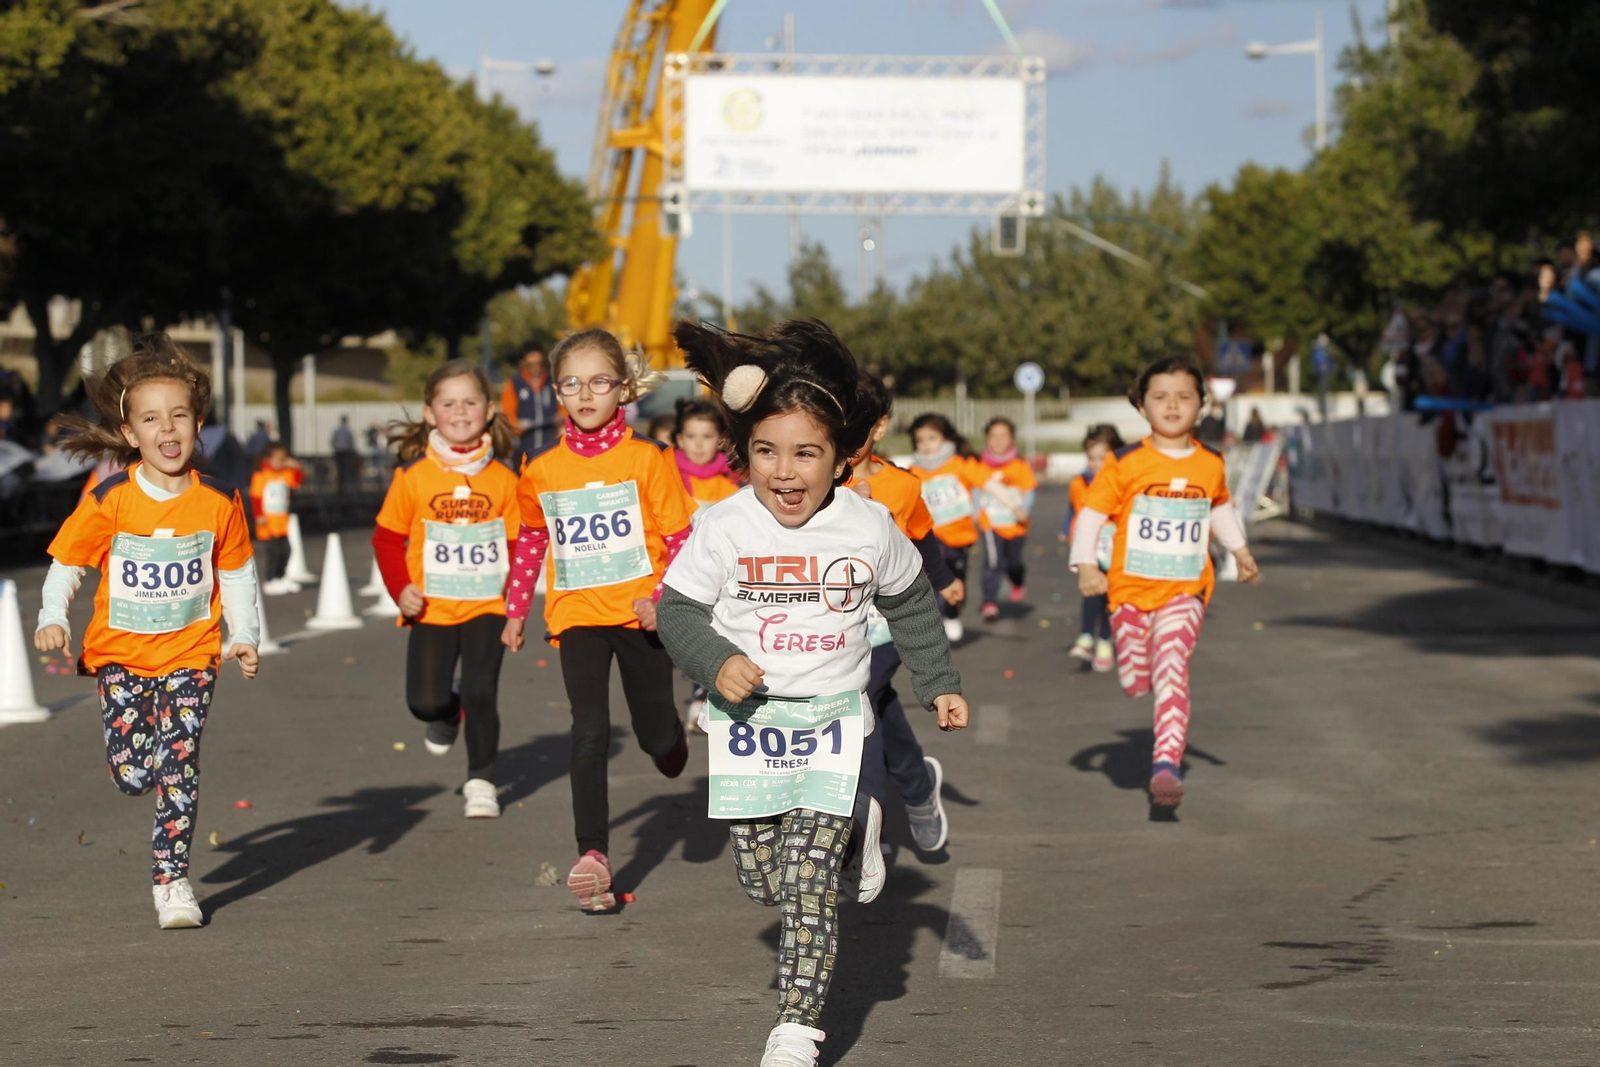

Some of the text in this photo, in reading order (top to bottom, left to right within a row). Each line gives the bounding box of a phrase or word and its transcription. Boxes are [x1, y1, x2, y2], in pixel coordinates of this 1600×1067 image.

[441, 498, 485, 509] SUPER
[436, 510, 489, 520] RUNNER
[555, 509, 632, 545] 8266
[1139, 517, 1201, 543] 8510
[435, 541, 499, 565] 8163
[574, 542, 607, 553] NOELIA
[122, 557, 204, 590] 8308
[738, 556, 819, 582] TRI
[134, 588, 189, 599] JIMENA M.O.
[105, 671, 125, 686] POP!
[176, 696, 199, 707] POP!
[806, 697, 850, 713] CARRERA
[807, 705, 851, 723] INFANTIL
[728, 718, 843, 757] 8051
[111, 748, 133, 766] POP!
[764, 757, 809, 769] TERESA
[162, 773, 183, 786] POP!
